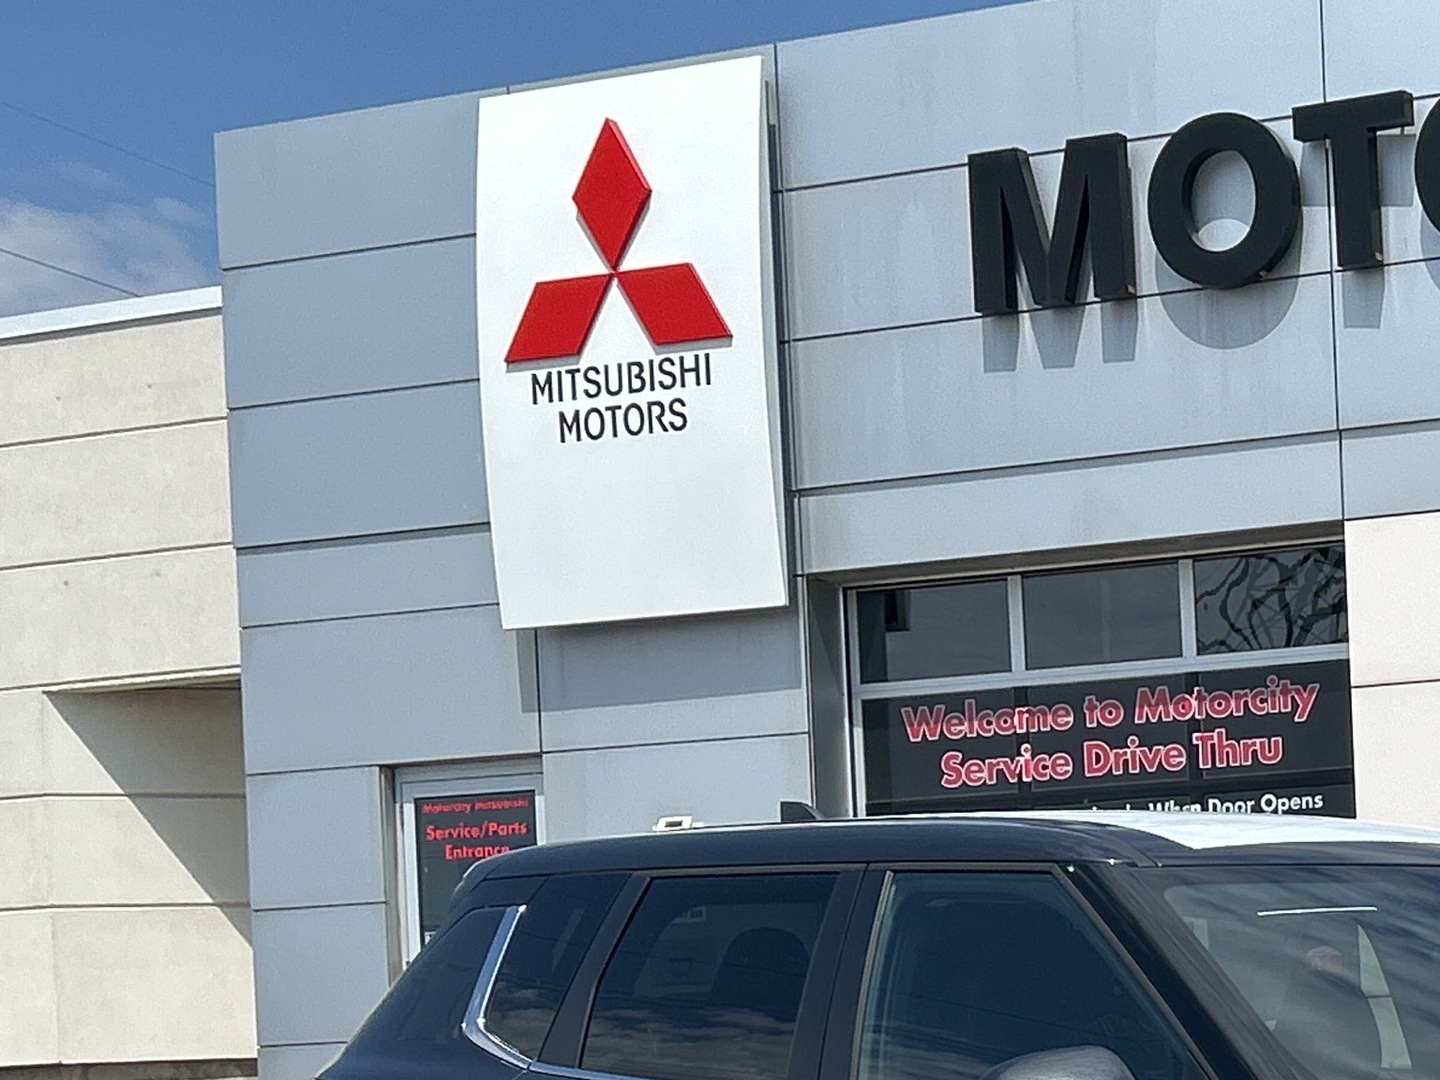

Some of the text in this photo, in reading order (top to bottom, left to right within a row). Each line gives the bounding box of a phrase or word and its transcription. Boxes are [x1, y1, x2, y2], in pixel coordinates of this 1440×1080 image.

[531, 353, 711, 405] MITSUBISHI
[558, 398, 687, 443] MOTORS
[901, 675, 1320, 742] Welcome to Motorcity
[941, 728, 1282, 788] Service Drive Thru
[1208, 798, 1255, 814] Door
[1260, 793, 1323, 815] Opens
[426, 820, 527, 840] Service/Parts
